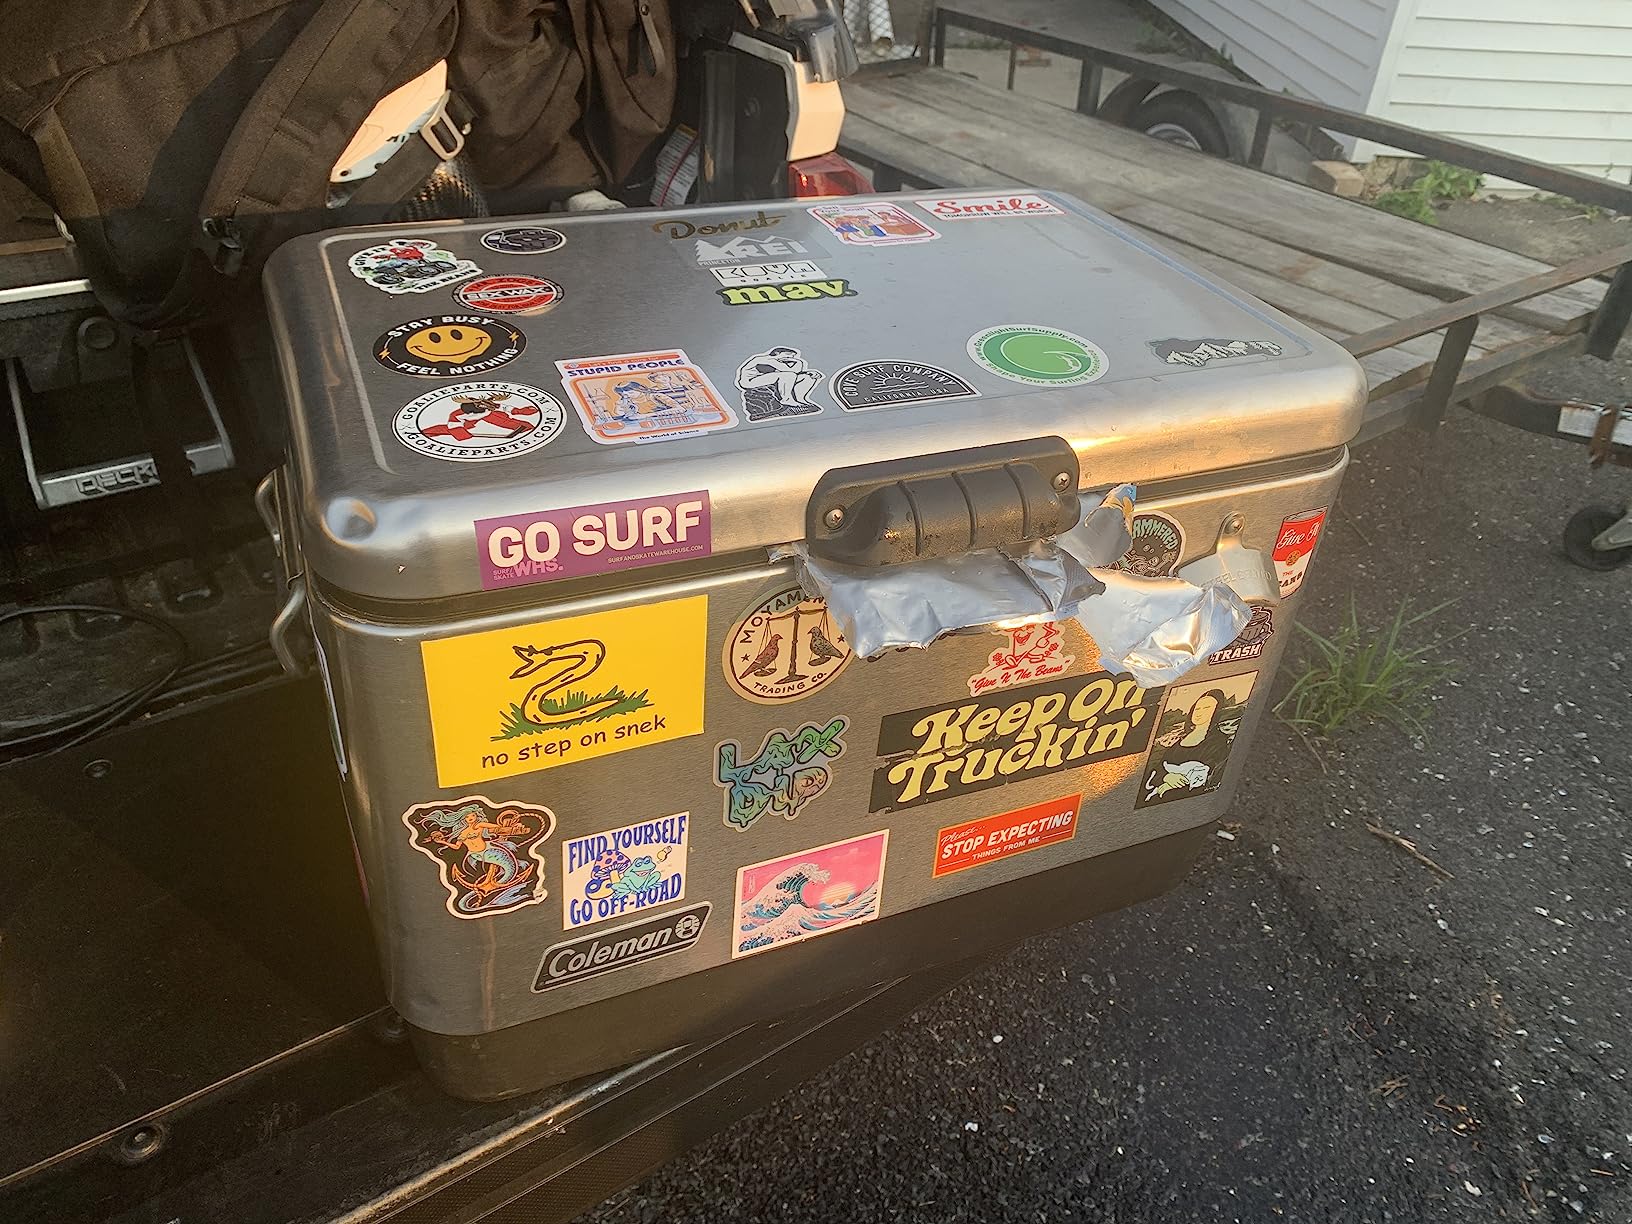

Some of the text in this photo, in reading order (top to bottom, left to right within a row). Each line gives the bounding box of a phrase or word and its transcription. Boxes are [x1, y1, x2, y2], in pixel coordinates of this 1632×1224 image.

[934, 198, 1048, 214] Smile
[652, 210, 786, 239] Donut
[733, 240, 809, 258] REI
[698, 258, 742, 266] PRINCETON
[740, 274, 807, 283] GOALIE
[466, 287, 545, 300] SEX WAX
[387, 315, 495, 338] STAY BUSY
[396, 347, 519, 375] FEEL NOTHING
[568, 359, 684, 377] STUPID PEOPLE
[844, 364, 956, 397] COVE SURF COMPANY
[986, 363, 1016, 378] Shape
[1020, 376, 1046, 385] Your
[402, 383, 550, 420] GOALIEPARTS.COM
[408, 416, 556, 456] GOALIEPARTS.COM
[488, 500, 702, 568] GO SURF
[1132, 518, 1178, 550] AMMERED
[1276, 528, 1306, 550] Give
[607, 544, 704, 564] SURFANDSKATEWAREHOUSE.COM
[494, 572, 515, 582] SKATE
[514, 558, 564, 577] WHS.
[1278, 571, 1302, 588] EANS
[1213, 644, 1262, 662] TRASH
[1000, 672, 1012, 684] It
[1014, 668, 1032, 681] The
[753, 682, 806, 694] TRADING
[911, 678, 1146, 756] Keep On
[481, 714, 666, 768] no step on snek
[888, 708, 1146, 803] Truckin'
[568, 815, 686, 874] FIND YOURSELF
[942, 810, 1074, 860] STOP EXPECTING
[972, 836, 1040, 860] THINGS FROM ME
[570, 872, 681, 925] GO OFF-ROAD
[548, 927, 672, 978] Coleman
